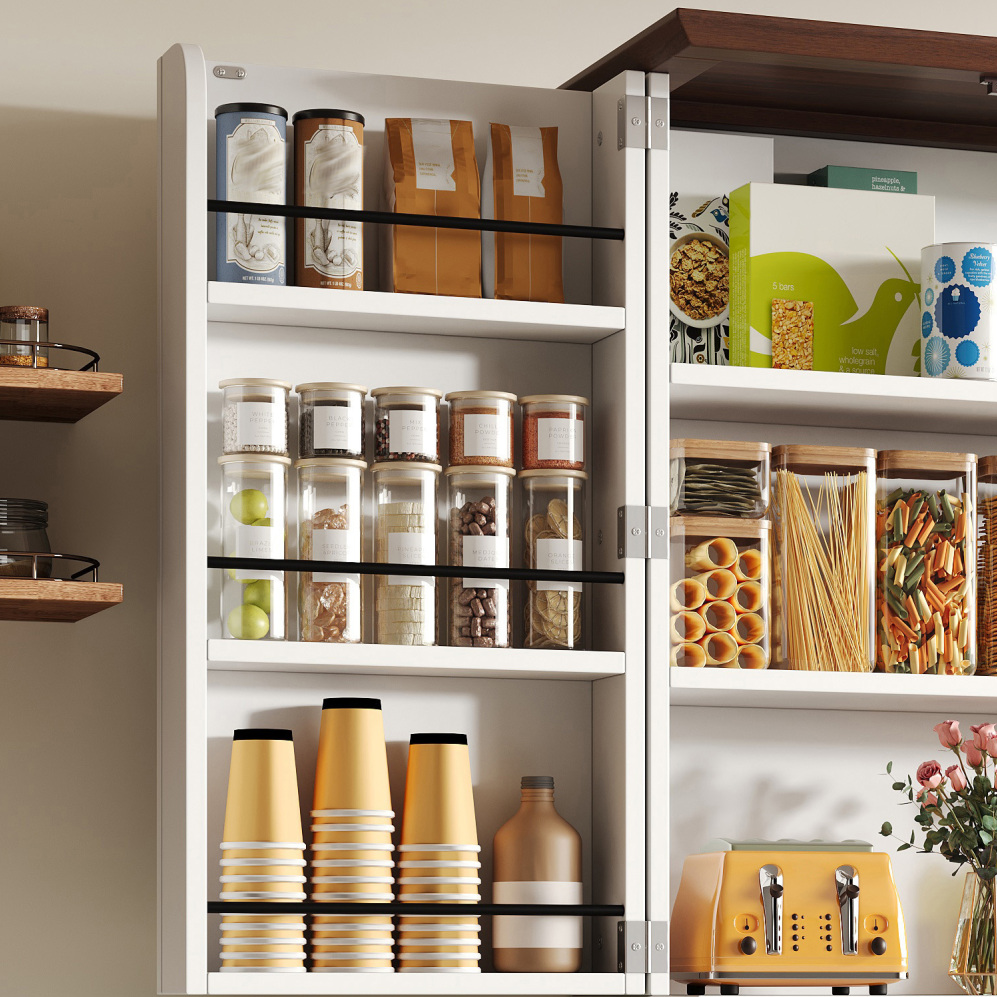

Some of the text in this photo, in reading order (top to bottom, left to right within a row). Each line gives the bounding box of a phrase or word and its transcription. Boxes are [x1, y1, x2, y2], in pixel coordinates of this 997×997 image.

[872, 183, 900, 192] hazelnuts
[773, 282, 795, 292] 5 bars
[852, 347, 864, 356] low
[838, 356, 876, 367] wholegrain
